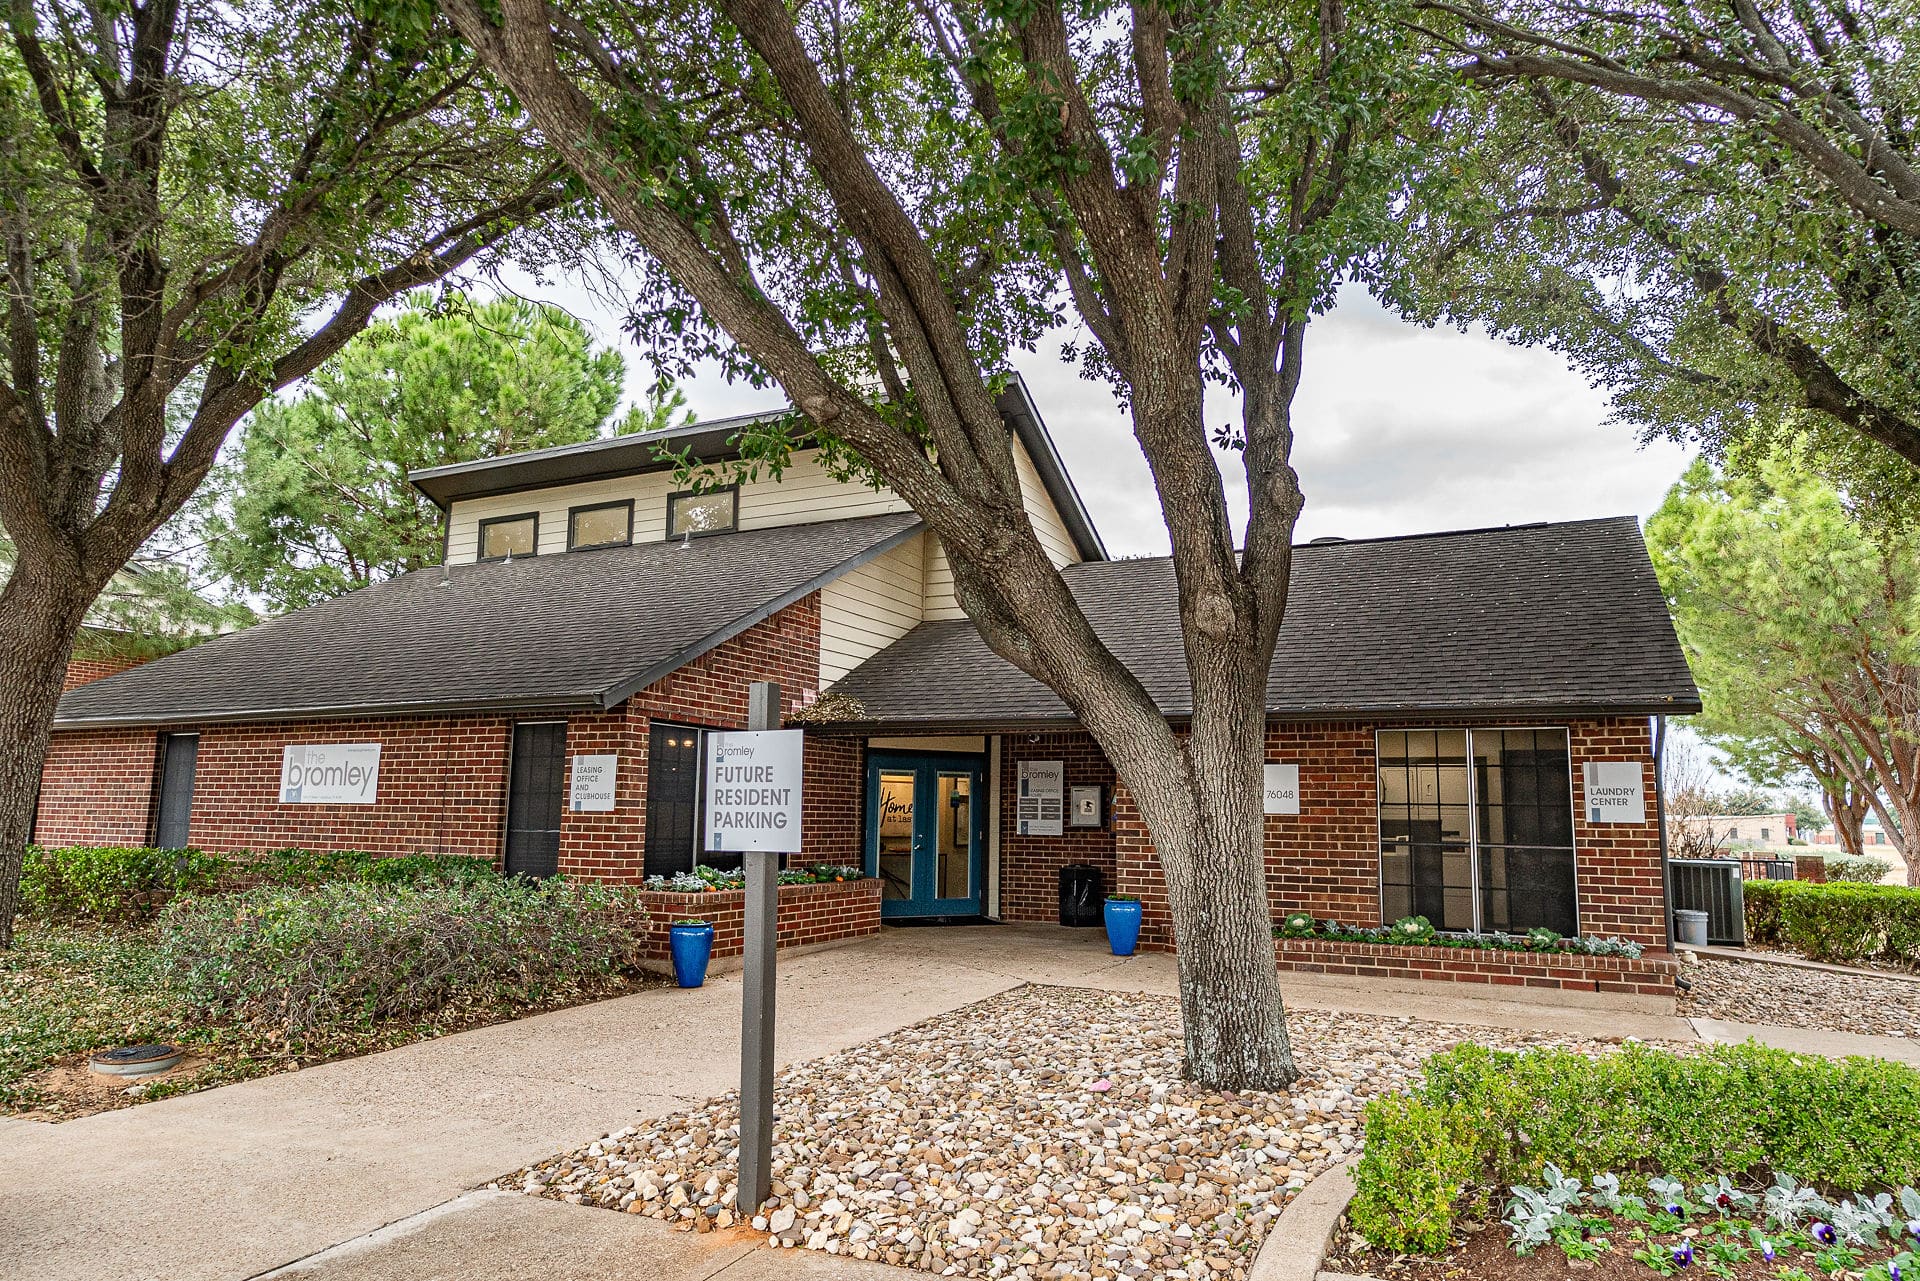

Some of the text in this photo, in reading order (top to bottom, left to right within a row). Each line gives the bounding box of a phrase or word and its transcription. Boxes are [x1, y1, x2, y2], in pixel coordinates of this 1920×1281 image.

[307, 751, 326, 764] the
[716, 745, 755, 759] bromley
[287, 756, 374, 796] bromley
[576, 766, 603, 774] LEASING
[715, 765, 774, 783] FUTURE
[1021, 768, 1060, 782] bromley
[576, 775, 599, 783] OFFICE
[574, 792, 612, 800] CLUBHOUSE
[714, 788, 791, 806] RESIDENT
[1266, 790, 1294, 799] 76048
[1590, 787, 1635, 796] LAUNDRY
[880, 787, 913, 828] Home
[1590, 797, 1629, 806] CENTER
[713, 811, 788, 829] PARKING
[886, 814, 912, 823] at las
